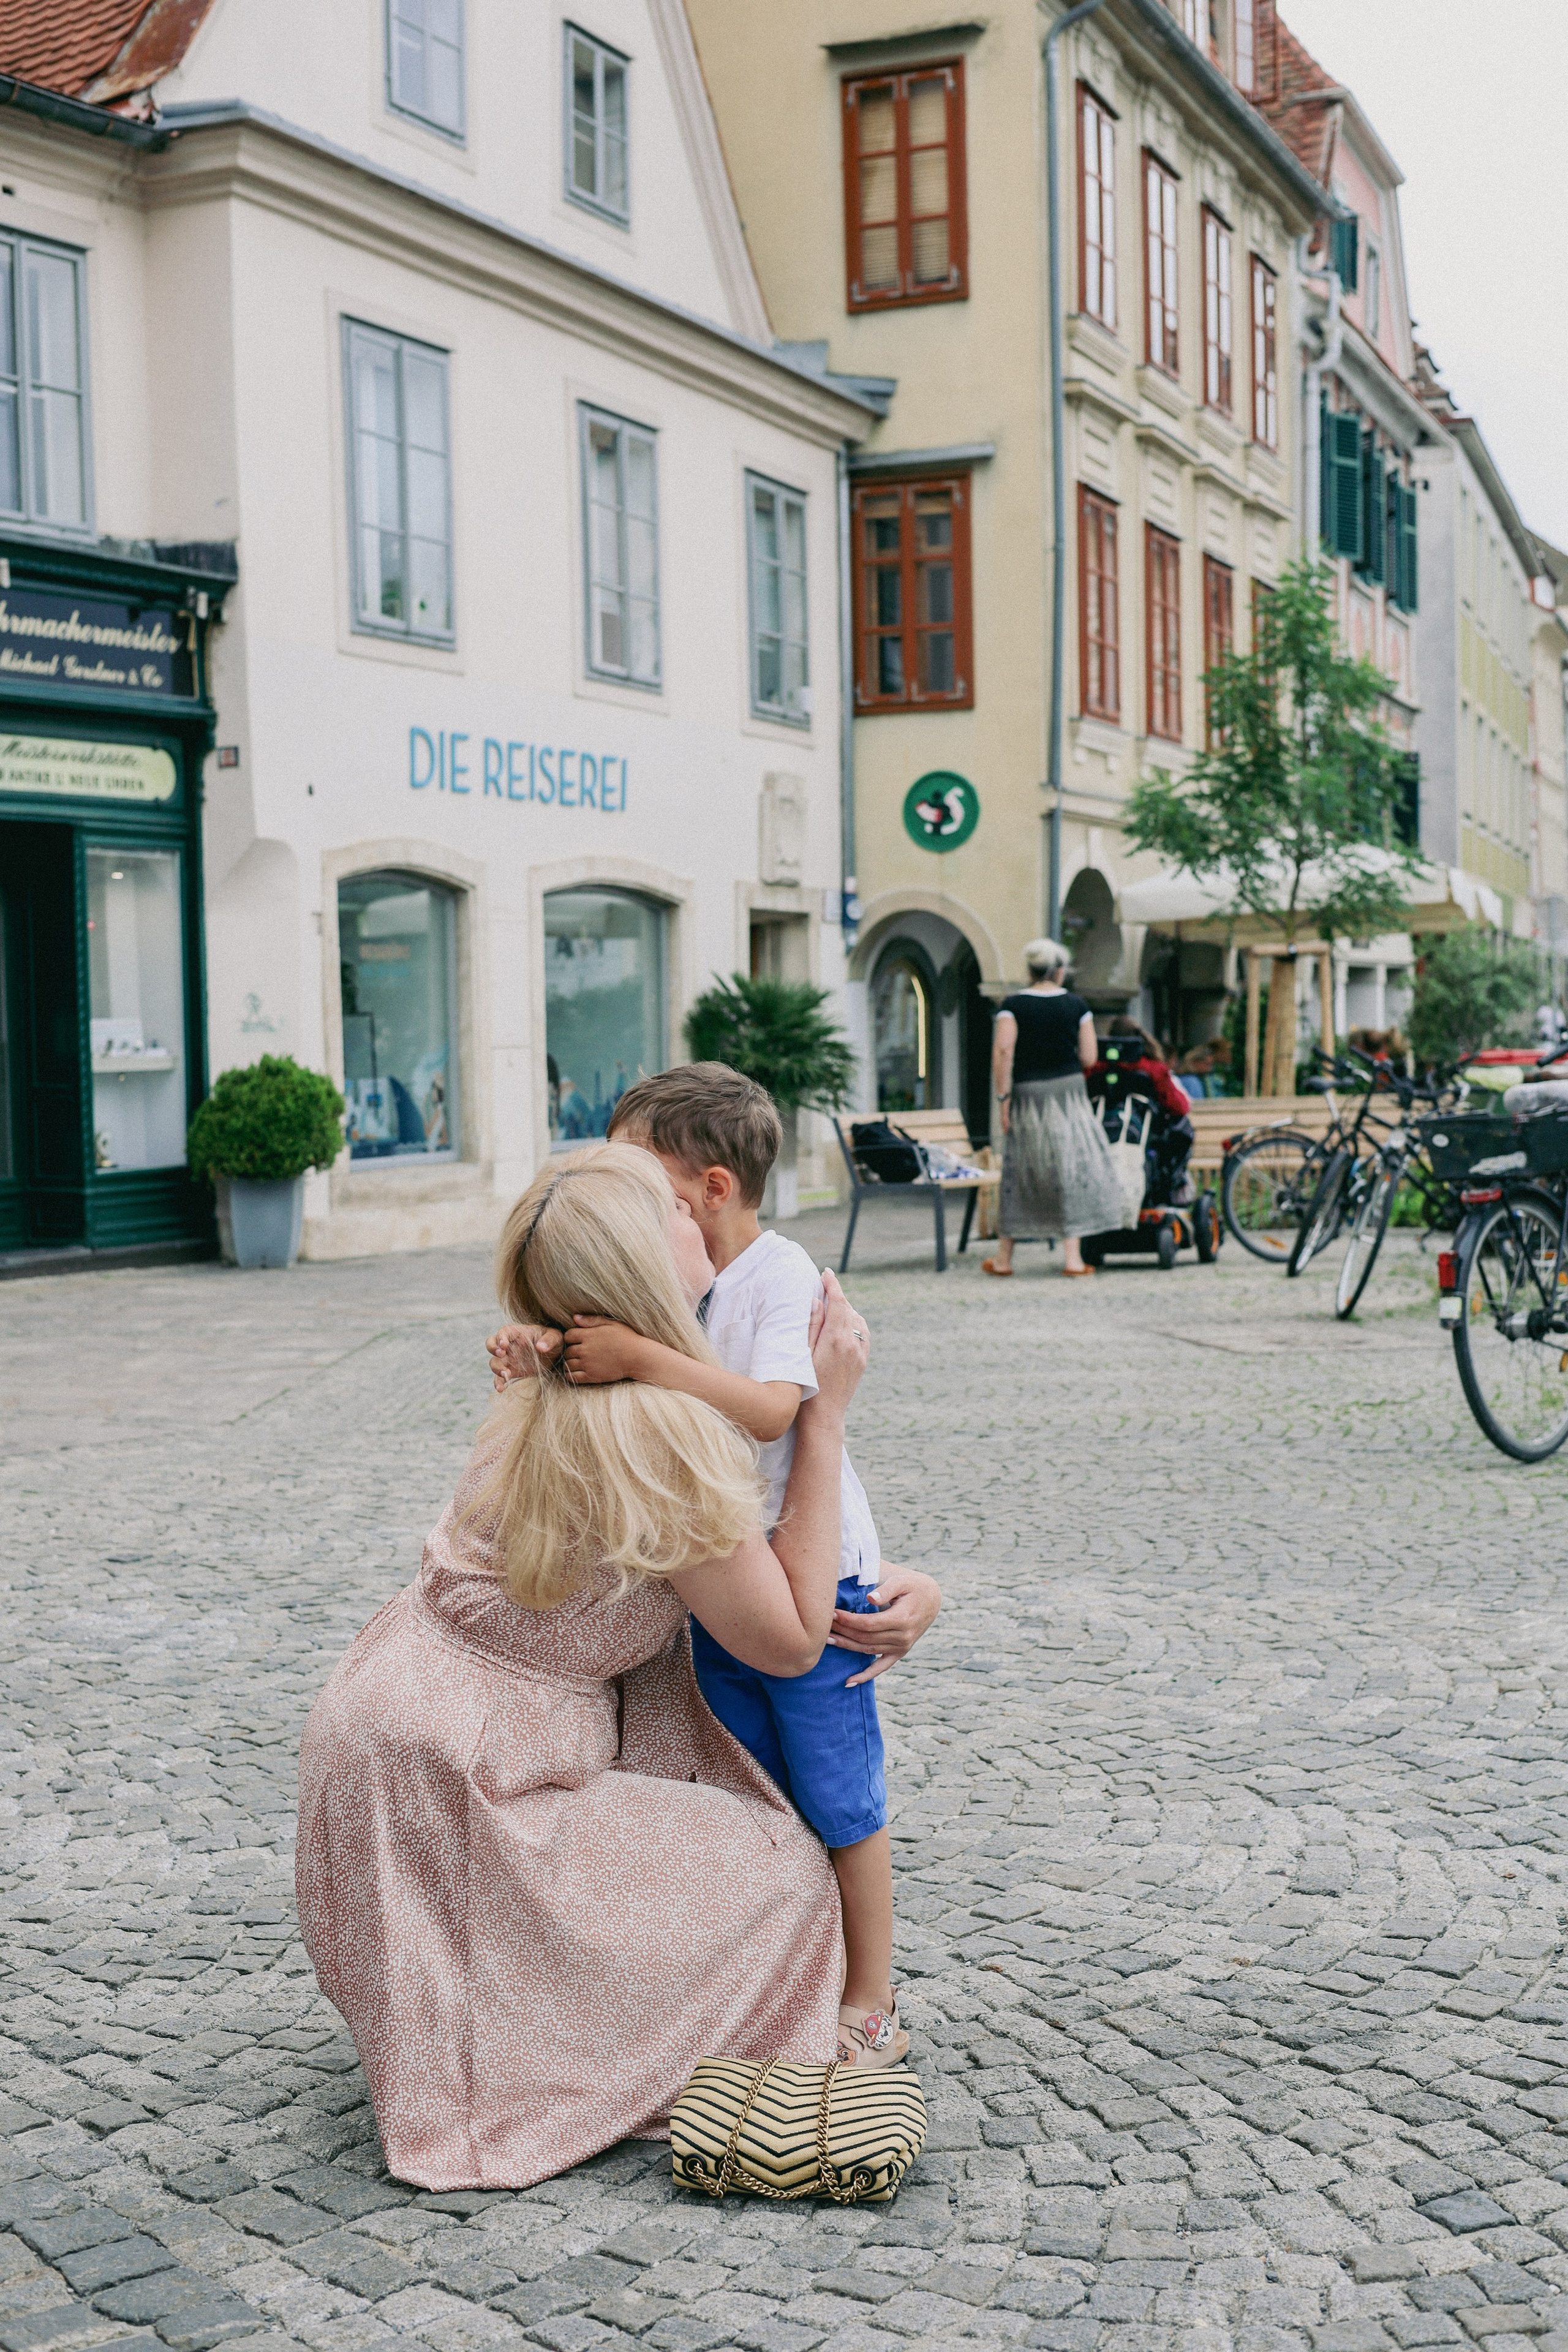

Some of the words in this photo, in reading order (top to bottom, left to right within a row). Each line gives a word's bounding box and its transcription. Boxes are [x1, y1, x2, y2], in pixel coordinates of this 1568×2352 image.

[127, 668, 140, 686] &
[409, 725, 471, 794] DIE
[483, 737, 627, 812] REISEREI
